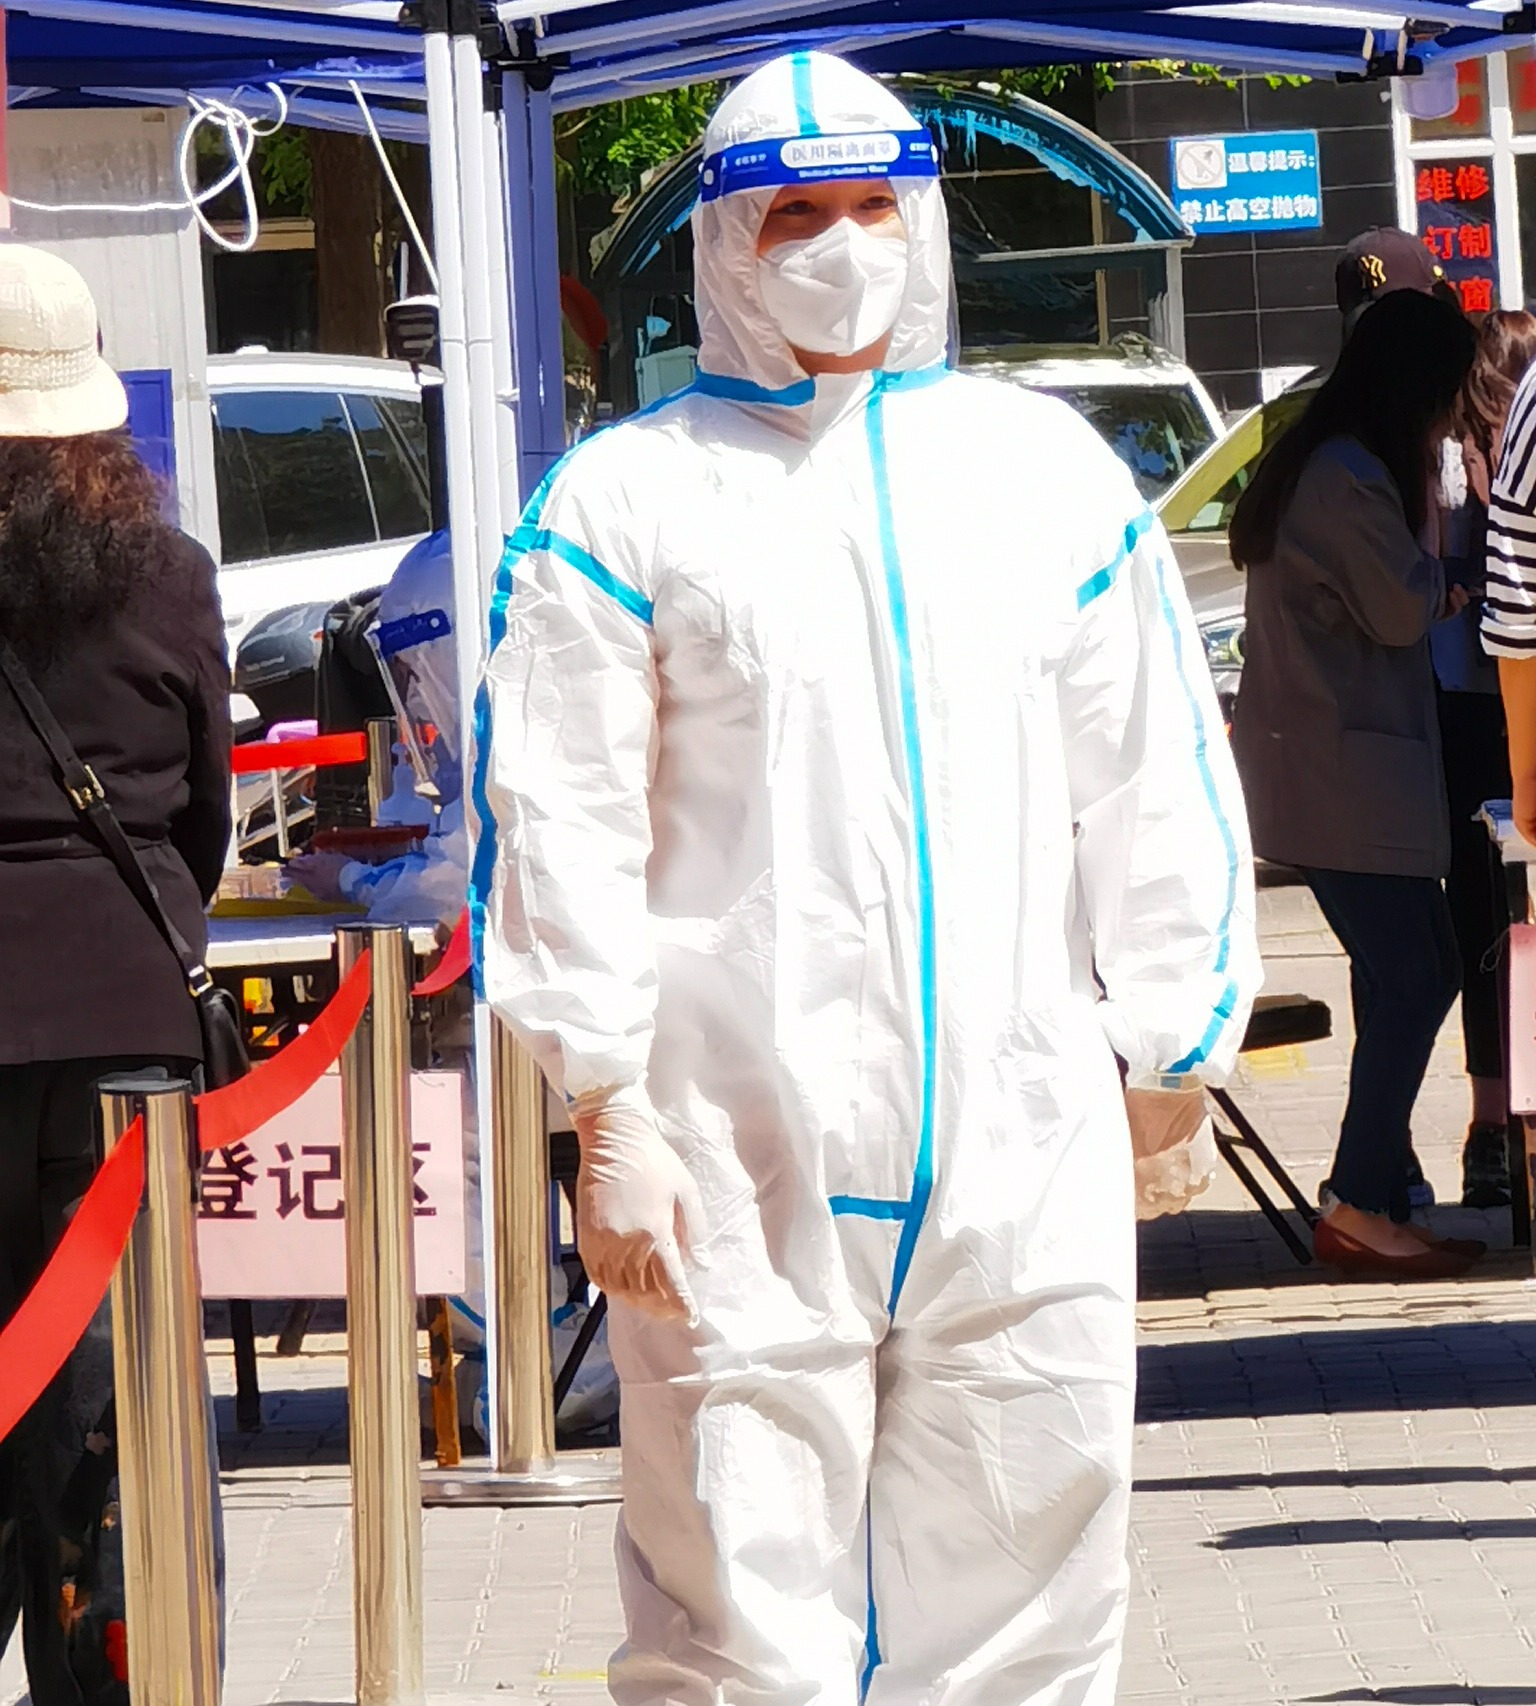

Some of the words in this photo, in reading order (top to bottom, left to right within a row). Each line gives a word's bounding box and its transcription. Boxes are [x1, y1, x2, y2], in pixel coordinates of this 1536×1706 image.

[1416, 164, 1489, 203] 维修
[1179, 194, 1317, 224] 禁止高空抛物
[1422, 222, 1492, 260] 订制
[1449, 275, 1493, 313] 窗
